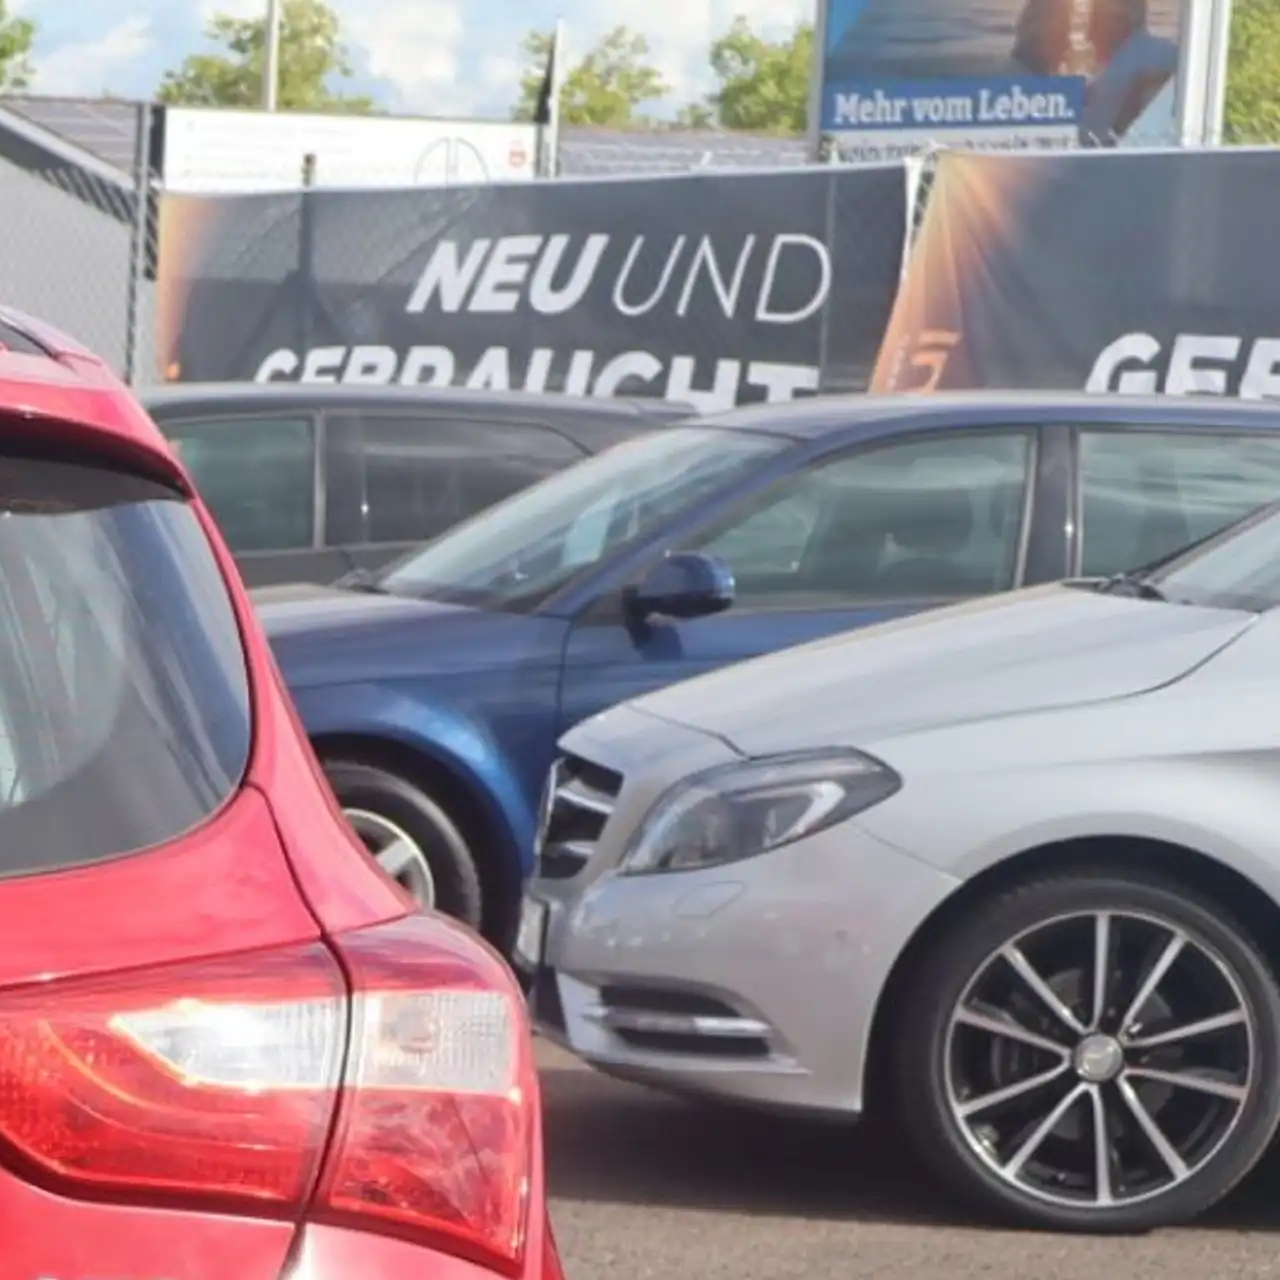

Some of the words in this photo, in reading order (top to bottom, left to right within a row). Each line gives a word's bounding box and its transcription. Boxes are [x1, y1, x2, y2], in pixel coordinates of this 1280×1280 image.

[834, 91, 908, 124] Mehr
[911, 97, 972, 122] vom
[977, 85, 1075, 121] Leben.
[404, 233, 610, 314] NEU
[612, 232, 832, 323] UND
